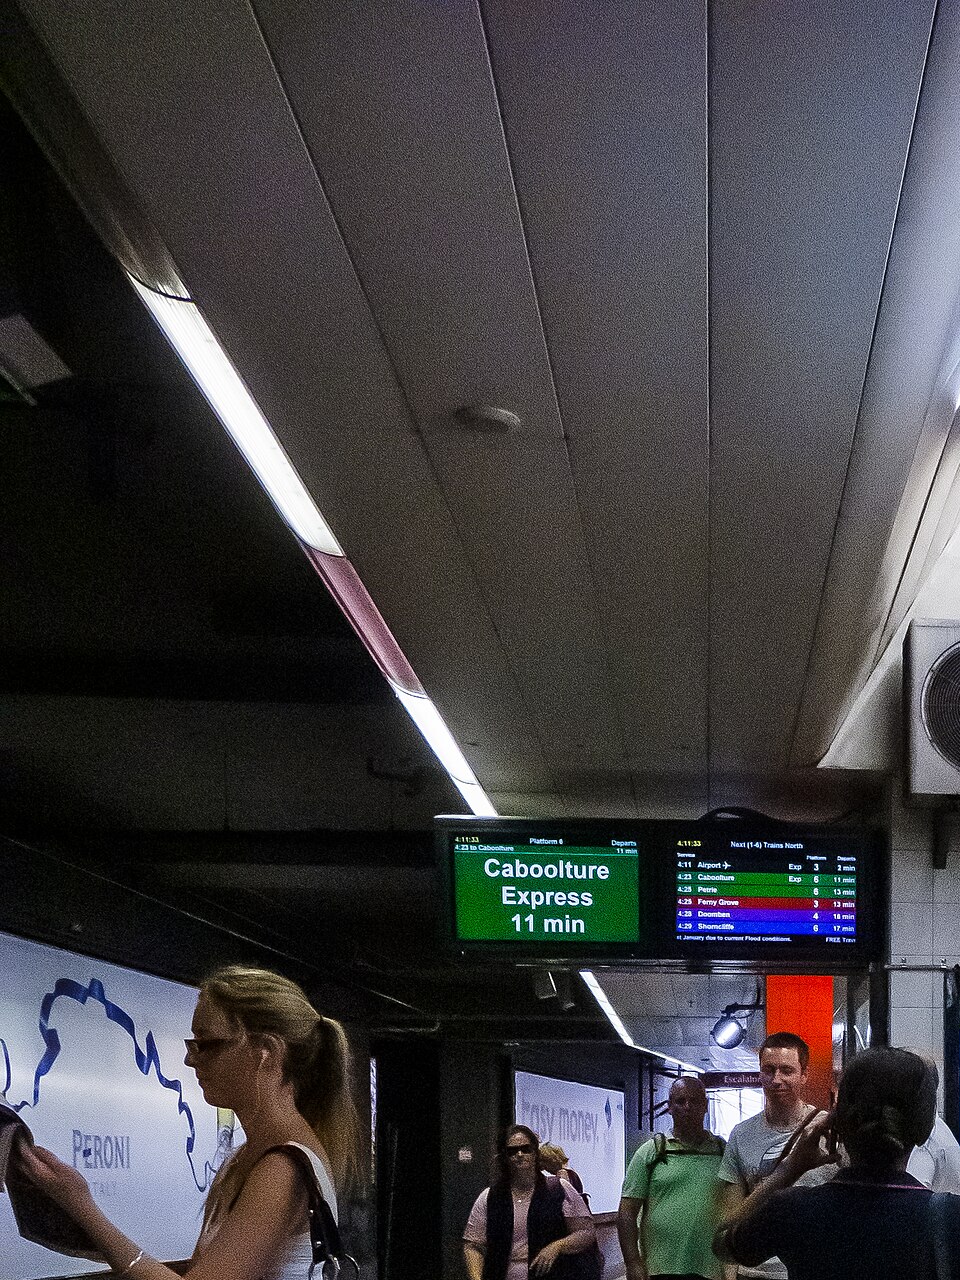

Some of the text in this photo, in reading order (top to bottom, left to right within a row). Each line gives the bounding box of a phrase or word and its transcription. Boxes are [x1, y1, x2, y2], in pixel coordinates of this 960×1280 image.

[529, 837, 558, 845] Platform
[611, 839, 637, 847] Departs
[484, 858, 610, 880] Caboolture
[697, 861, 721, 870] Airport
[788, 863, 802, 871] Exp
[813, 863, 819, 871] 3
[697, 873, 735, 881] Caboolture
[788, 875, 802, 883] Exp
[813, 875, 819, 883] 6
[813, 887, 819, 895] 6
[501, 886, 593, 910] Express
[813, 900, 819, 908] 3
[813, 912, 819, 920] 4
[511, 913, 585, 934] 11 min
[813, 924, 819, 932] 6
[72, 1129, 131, 1169] PERONI
